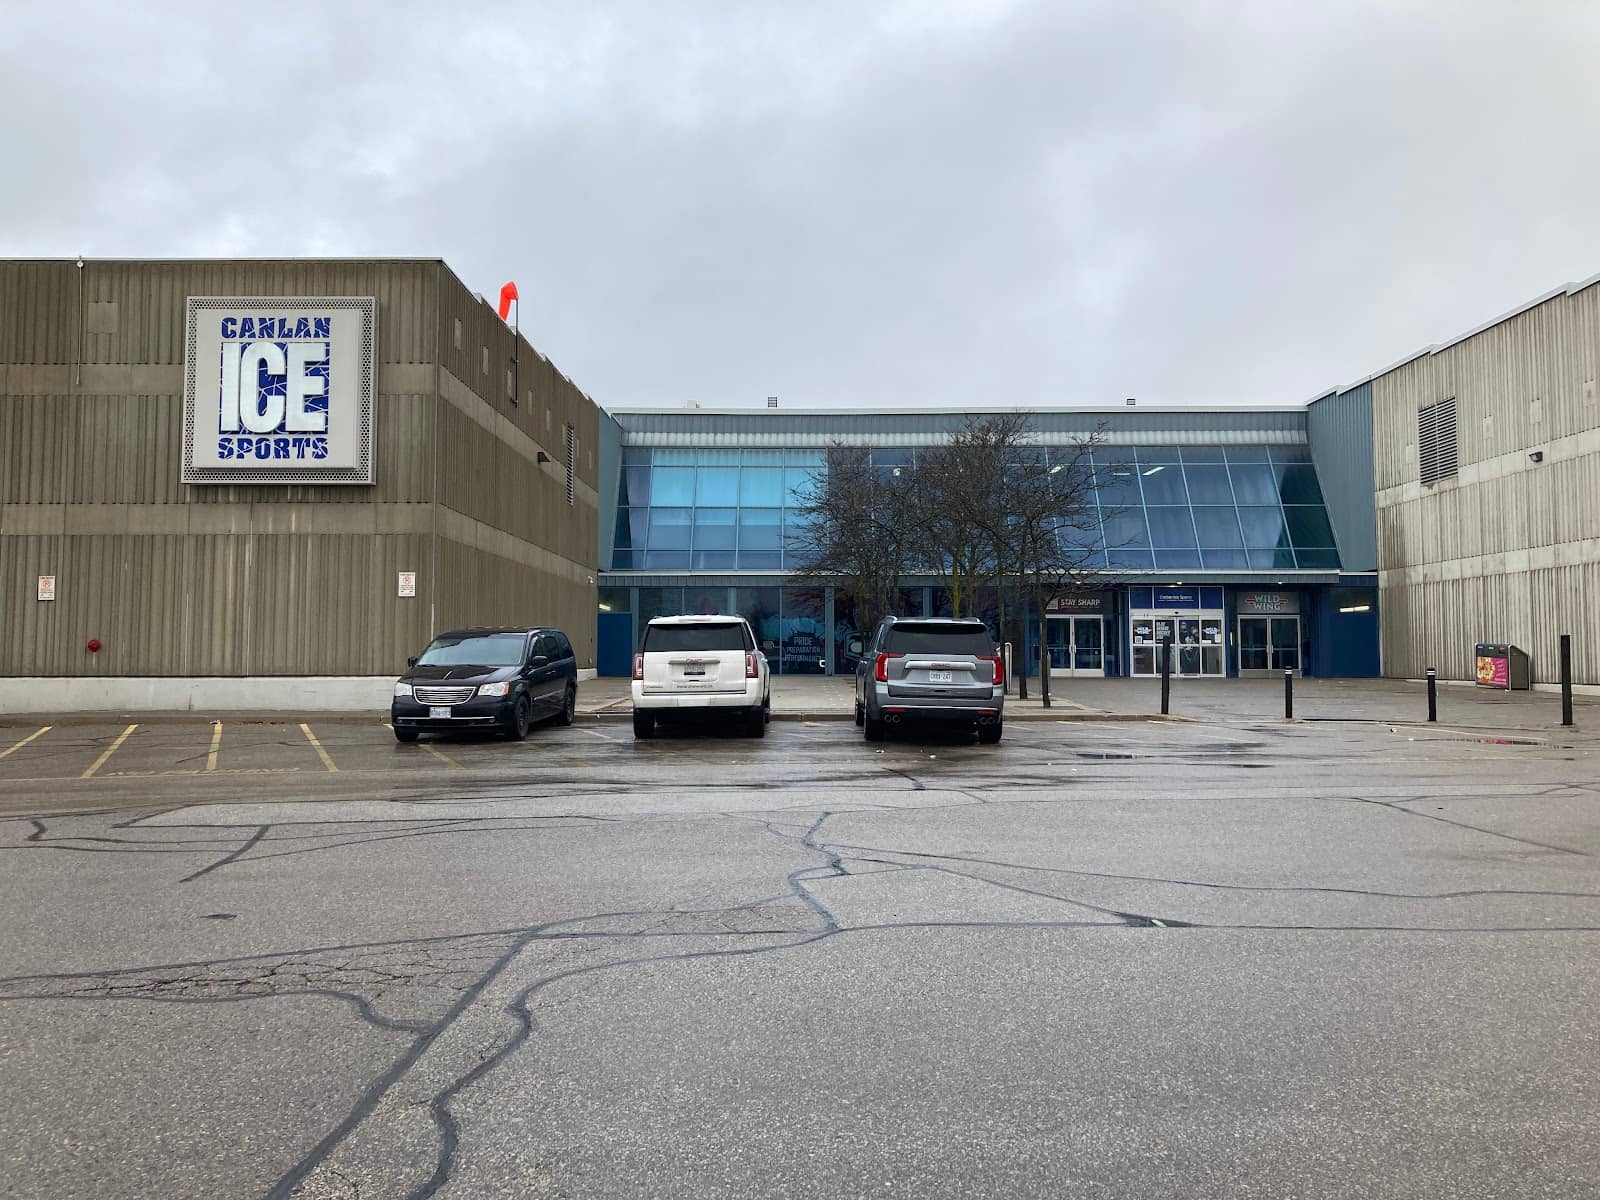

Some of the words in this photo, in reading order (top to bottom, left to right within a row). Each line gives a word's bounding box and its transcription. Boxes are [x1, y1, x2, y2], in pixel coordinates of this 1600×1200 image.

[221, 317, 331, 338] CANLAN
[220, 341, 328, 433] ICE
[218, 437, 328, 459] SPORTS
[1060, 598, 1077, 606] STAY
[1077, 598, 1101, 606] SHARP
[1254, 594, 1280, 603] WILD
[1254, 602, 1281, 611] WING
[793, 636, 814, 646] PRIDE
